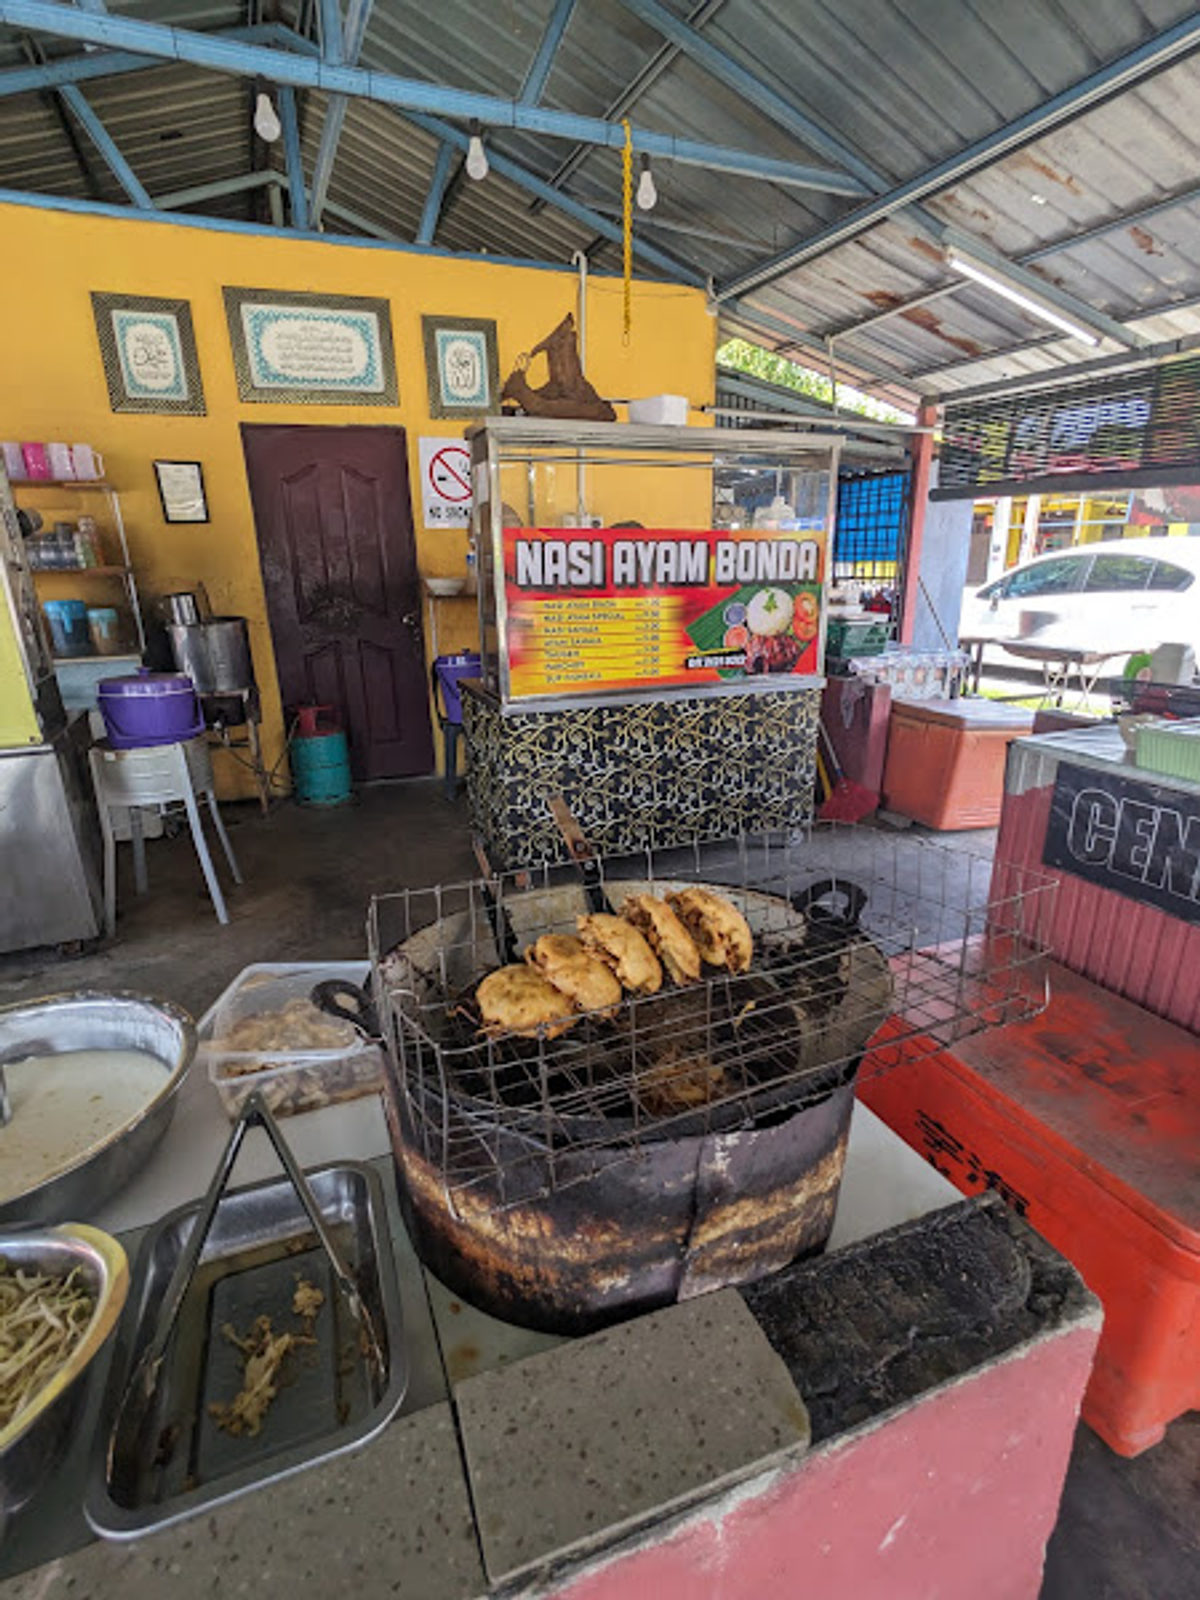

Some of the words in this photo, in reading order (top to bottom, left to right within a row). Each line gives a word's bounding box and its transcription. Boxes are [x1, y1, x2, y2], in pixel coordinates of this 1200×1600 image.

[516, 540, 604, 587] NASI
[613, 540, 707, 586] AYAM
[716, 540, 818, 584] BONDA
